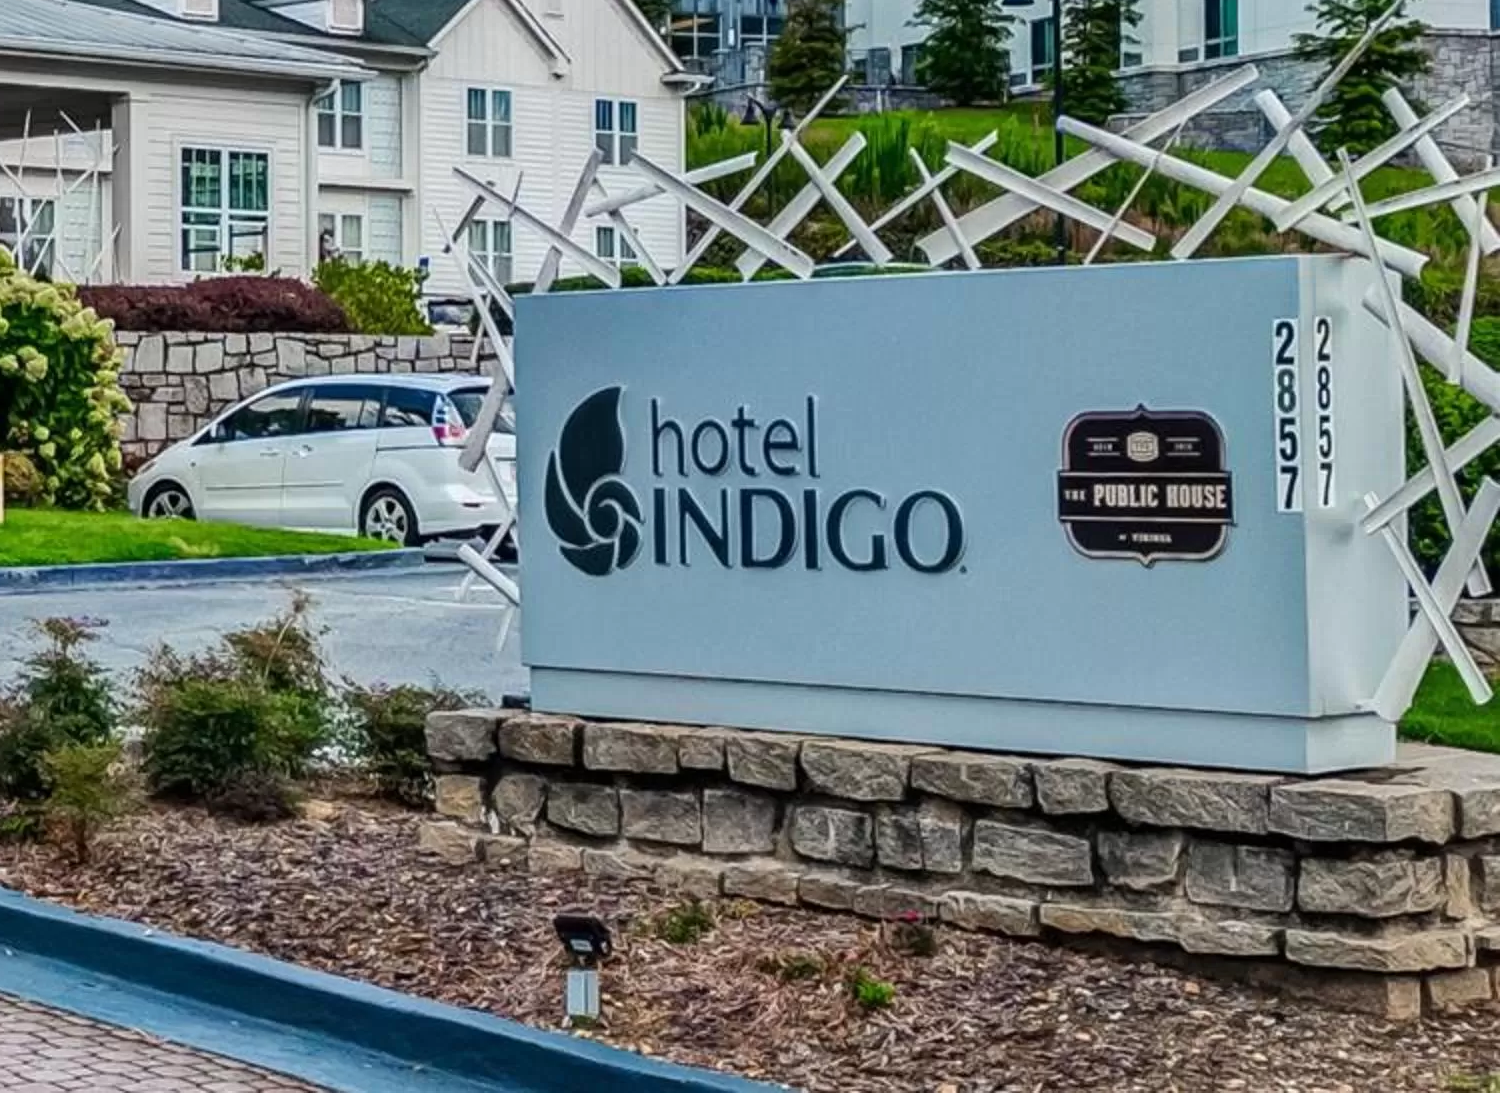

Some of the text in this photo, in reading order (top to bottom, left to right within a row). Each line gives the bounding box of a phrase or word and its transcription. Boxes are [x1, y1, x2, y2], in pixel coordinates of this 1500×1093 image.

[651, 395, 820, 477] hotel
[1275, 321, 1299, 510] 2857
[1316, 318, 1333, 506] 2857
[653, 488, 965, 574] INDIGO
[1093, 484, 1159, 508] PUBLIC
[1166, 484, 1227, 508] HOUSE
